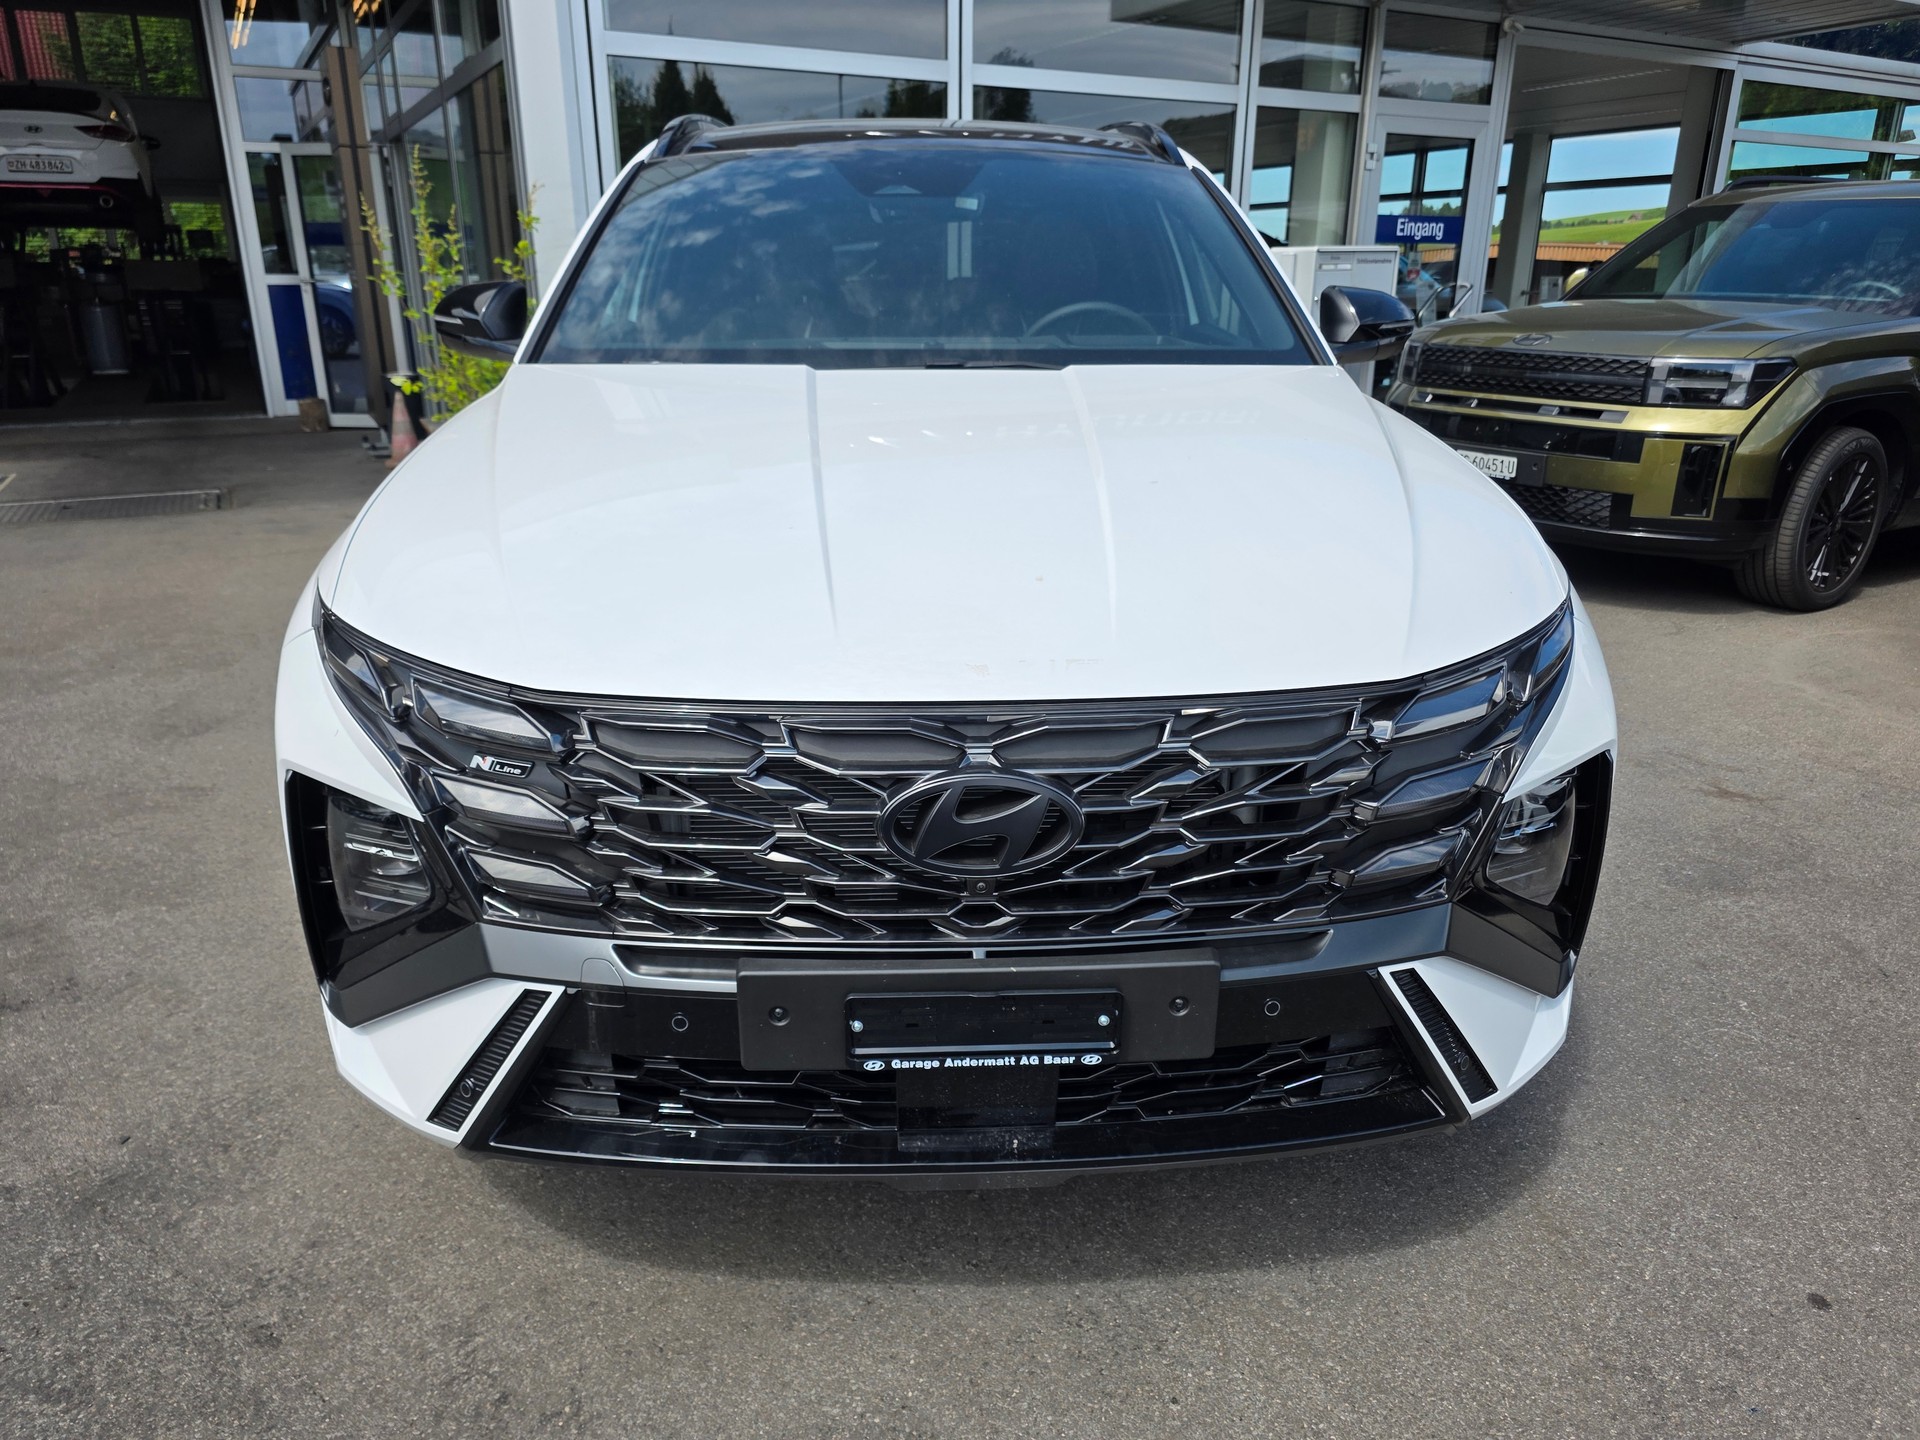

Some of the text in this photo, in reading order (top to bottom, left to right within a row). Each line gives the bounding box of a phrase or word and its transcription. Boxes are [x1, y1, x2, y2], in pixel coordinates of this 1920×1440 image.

[1396, 218, 1444, 240] Eingang
[495, 764, 522, 775] Line
[891, 1055, 1076, 1070] Garage Andermatt AG Baar
